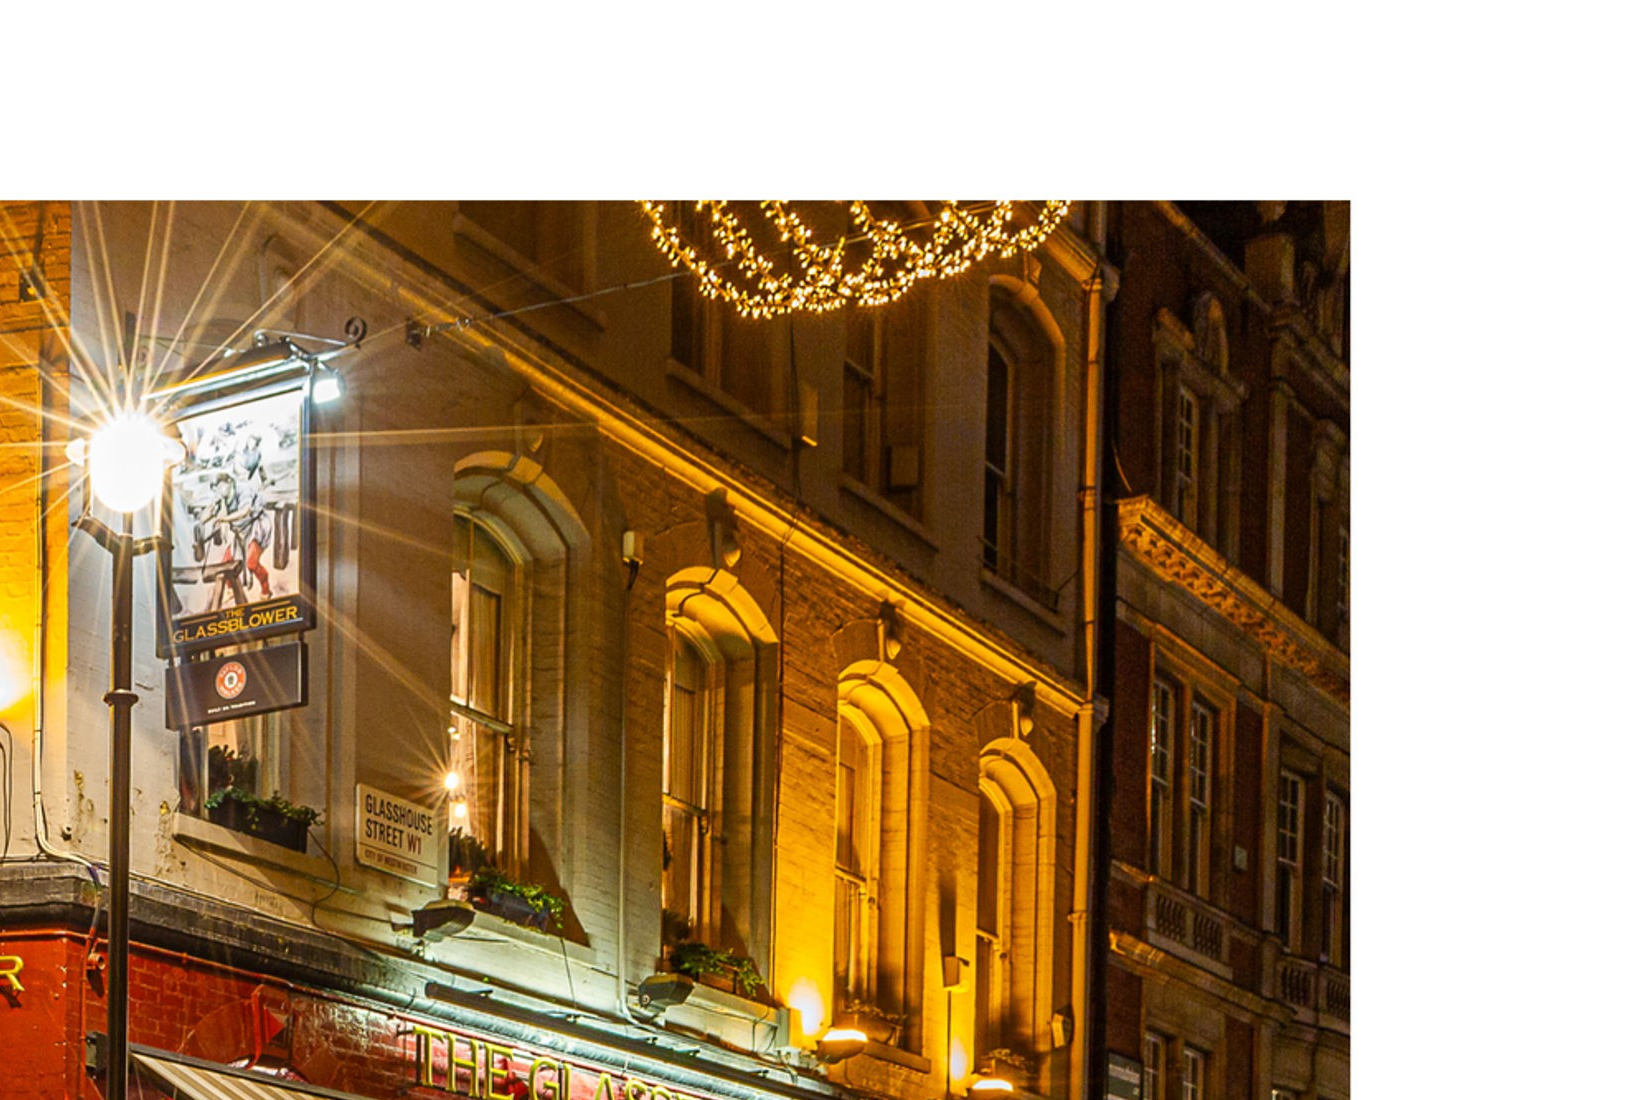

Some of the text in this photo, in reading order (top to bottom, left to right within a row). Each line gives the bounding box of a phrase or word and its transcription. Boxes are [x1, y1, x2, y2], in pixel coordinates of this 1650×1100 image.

[173, 606, 298, 643] GLASSBLOWER
[225, 608, 245, 618] THE
[365, 794, 433, 836] GLASSHOUSE
[365, 818, 422, 855] STREET W1
